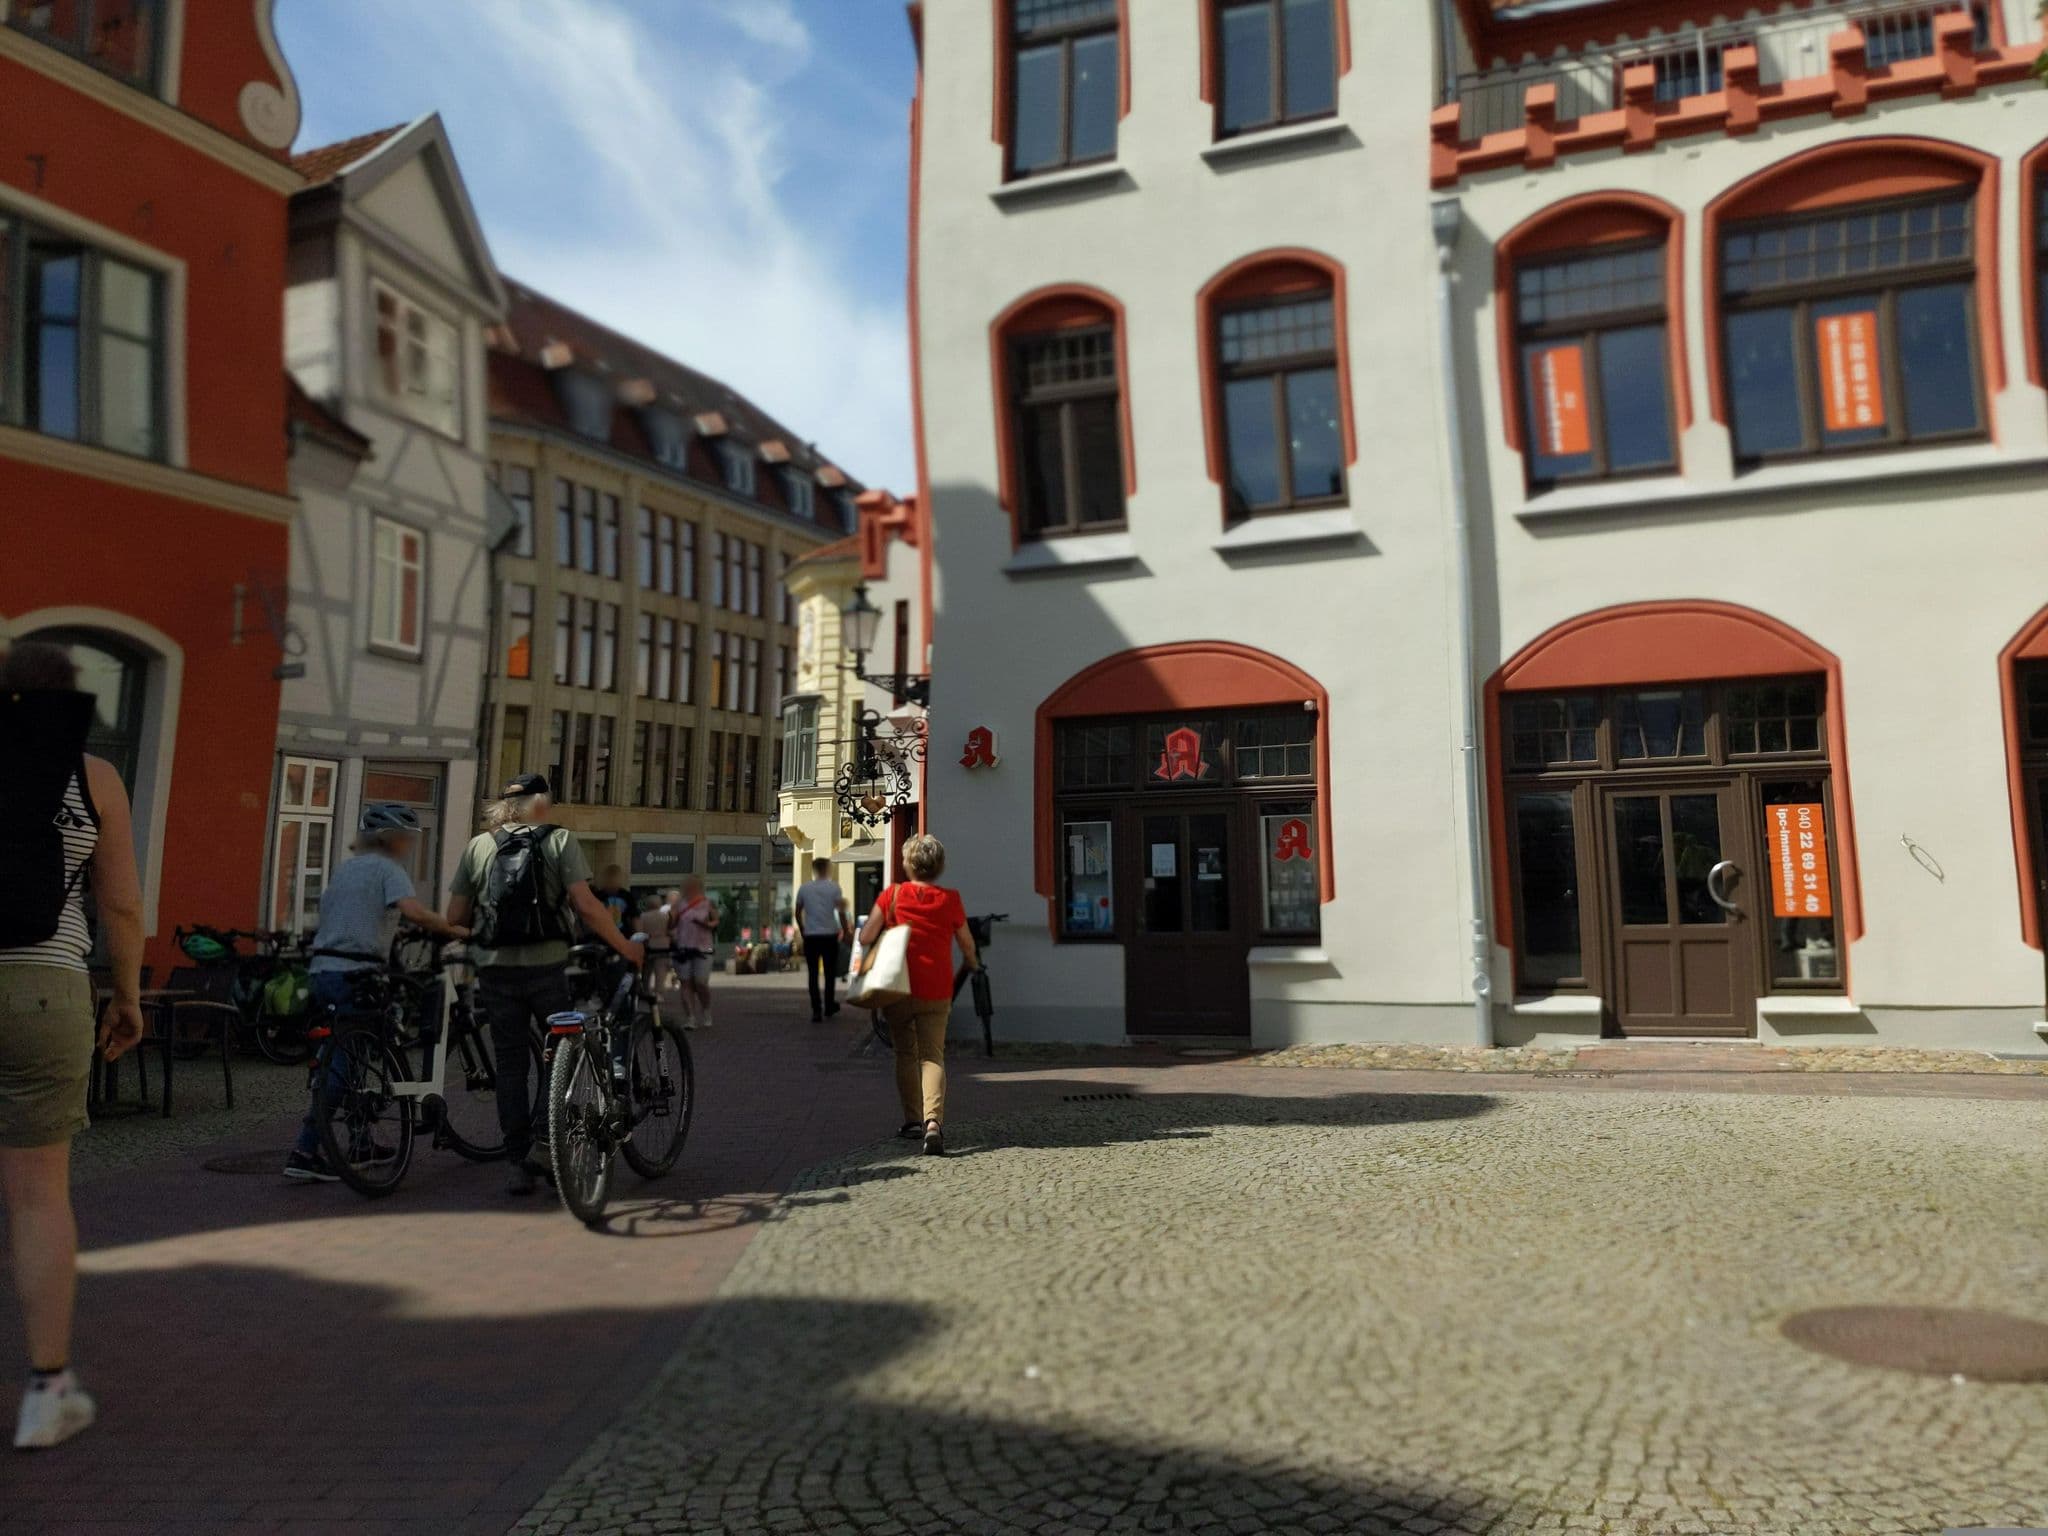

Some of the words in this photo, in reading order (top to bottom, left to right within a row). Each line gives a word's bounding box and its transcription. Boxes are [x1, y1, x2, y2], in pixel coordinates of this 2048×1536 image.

[1798, 808, 1811, 829] 040
[1800, 832, 1813, 848] 22
[1802, 853, 1816, 869] 69
[1803, 873, 1817, 890] 31
[1805, 894, 1819, 912] 40
